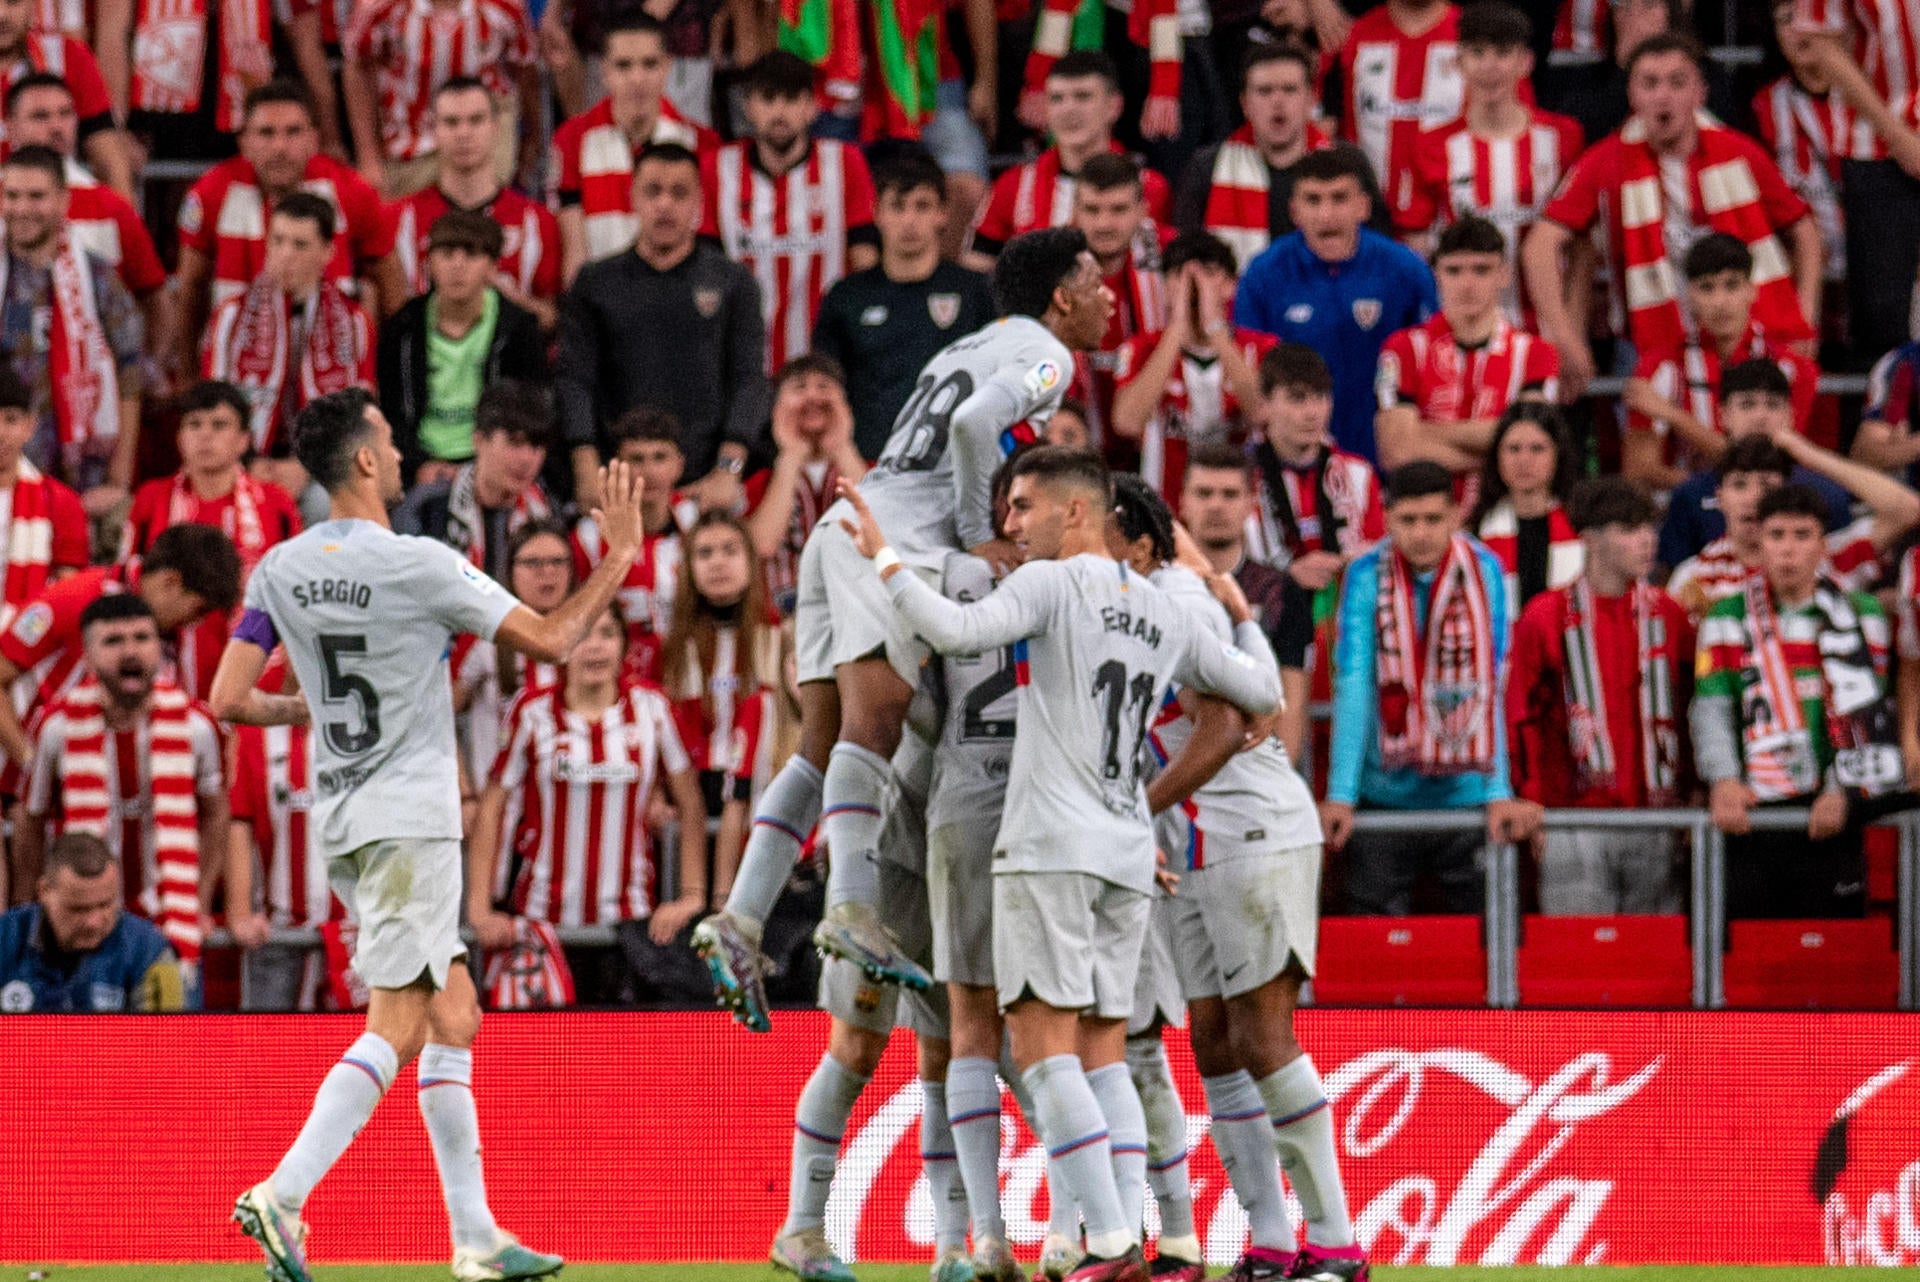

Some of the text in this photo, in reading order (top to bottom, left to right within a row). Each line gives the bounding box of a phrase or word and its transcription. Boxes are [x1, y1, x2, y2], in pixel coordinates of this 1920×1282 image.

[292, 579, 372, 609] SERGIO
[312, 633, 382, 758] 5
[1090, 658, 1156, 781] 11
